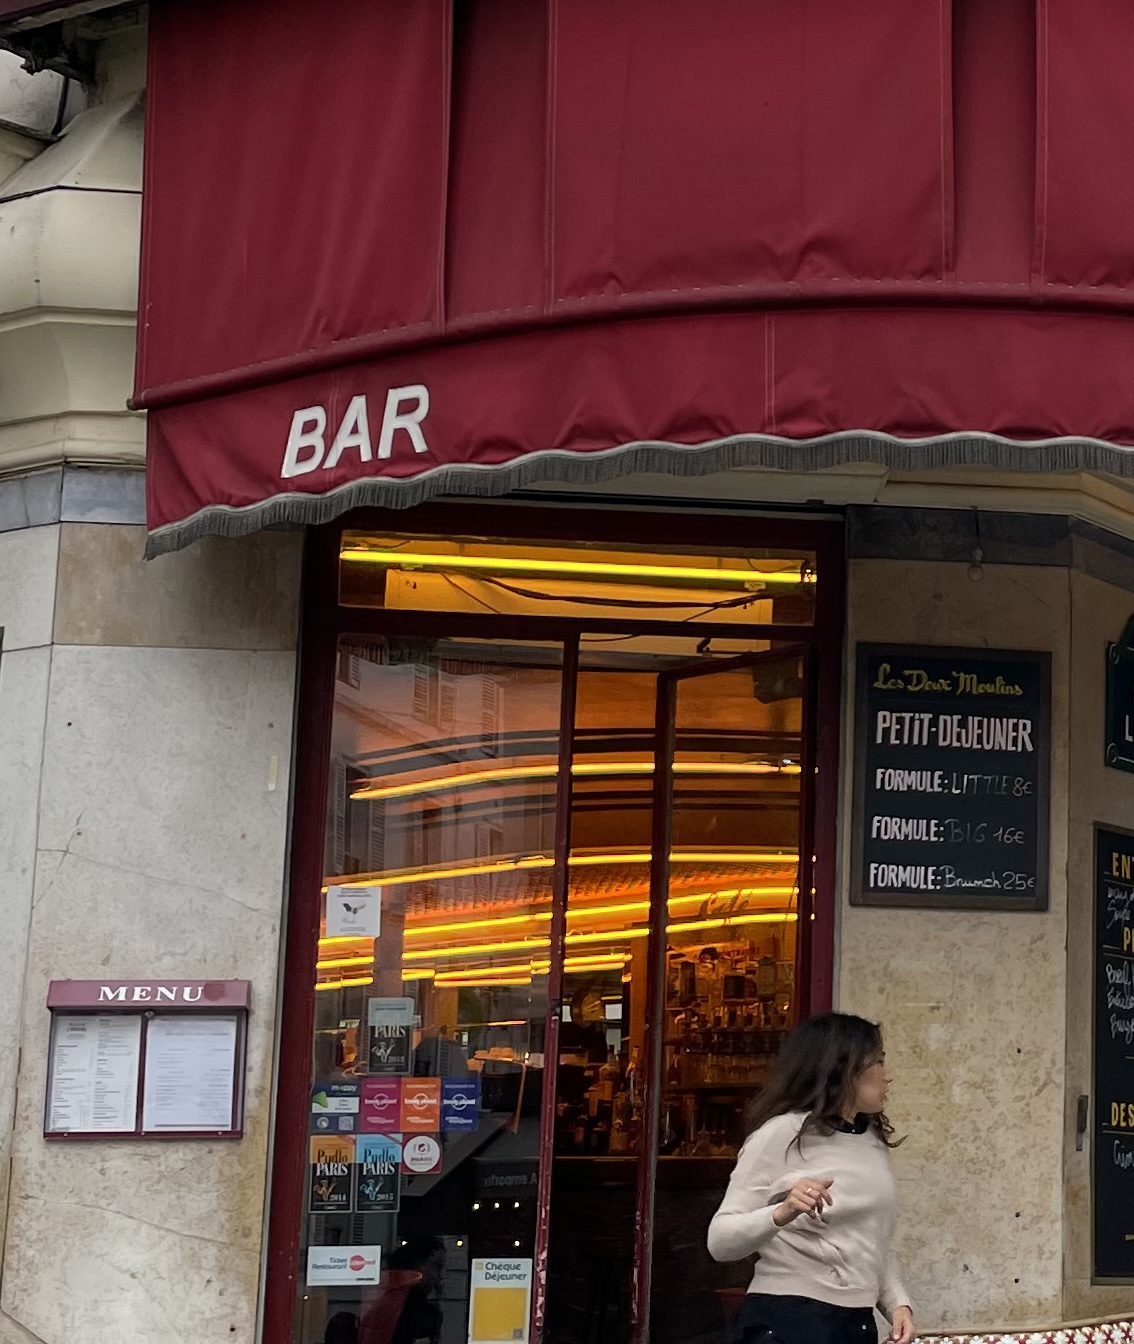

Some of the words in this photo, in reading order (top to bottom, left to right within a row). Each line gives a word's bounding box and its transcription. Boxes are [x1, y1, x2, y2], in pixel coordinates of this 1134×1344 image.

[280, 384, 430, 479] BAR
[873, 662, 904, 690] Les
[952, 670, 1024, 696] Moulins
[876, 768, 949, 793] FORMULE:
[1012, 777, 1033, 797] 8€
[871, 815, 945, 842] FORMULE:
[992, 826, 1025, 845] 16€
[869, 862, 941, 890] FORMULE:
[939, 865, 1001, 889] Brunch
[1002, 870, 1036, 890] 25€
[97, 986, 204, 1002] MENU
[316, 1162, 349, 1176] PARIS
[362, 1161, 396, 1176] PARIS
[484, 1271, 528, 1283] Déjeuner
[485, 1261, 521, 1271] Chèque
